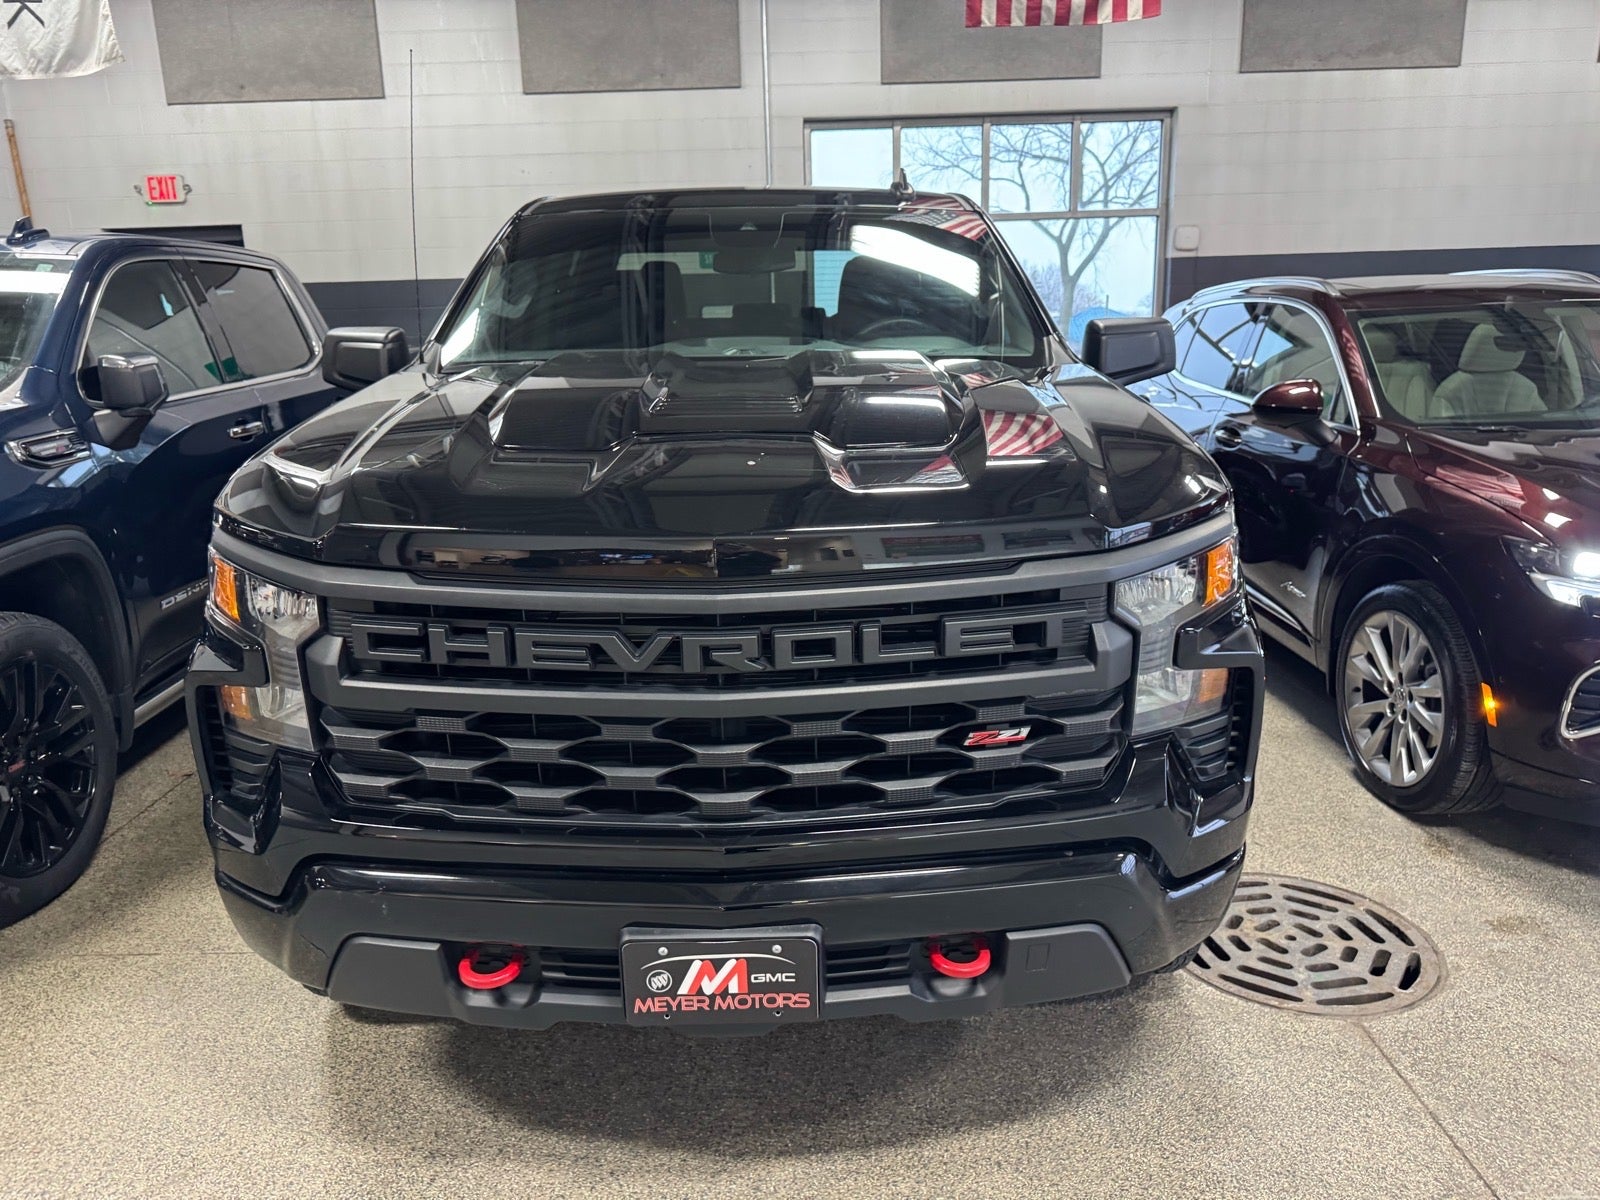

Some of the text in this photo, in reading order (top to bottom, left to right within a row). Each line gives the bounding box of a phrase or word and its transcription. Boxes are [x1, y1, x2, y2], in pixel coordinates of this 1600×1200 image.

[146, 175, 178, 201] EXIT
[350, 603, 1088, 674] CHEVROLET
[751, 972, 796, 983] GMC
[633, 992, 811, 1014] MEYER MOTORS
